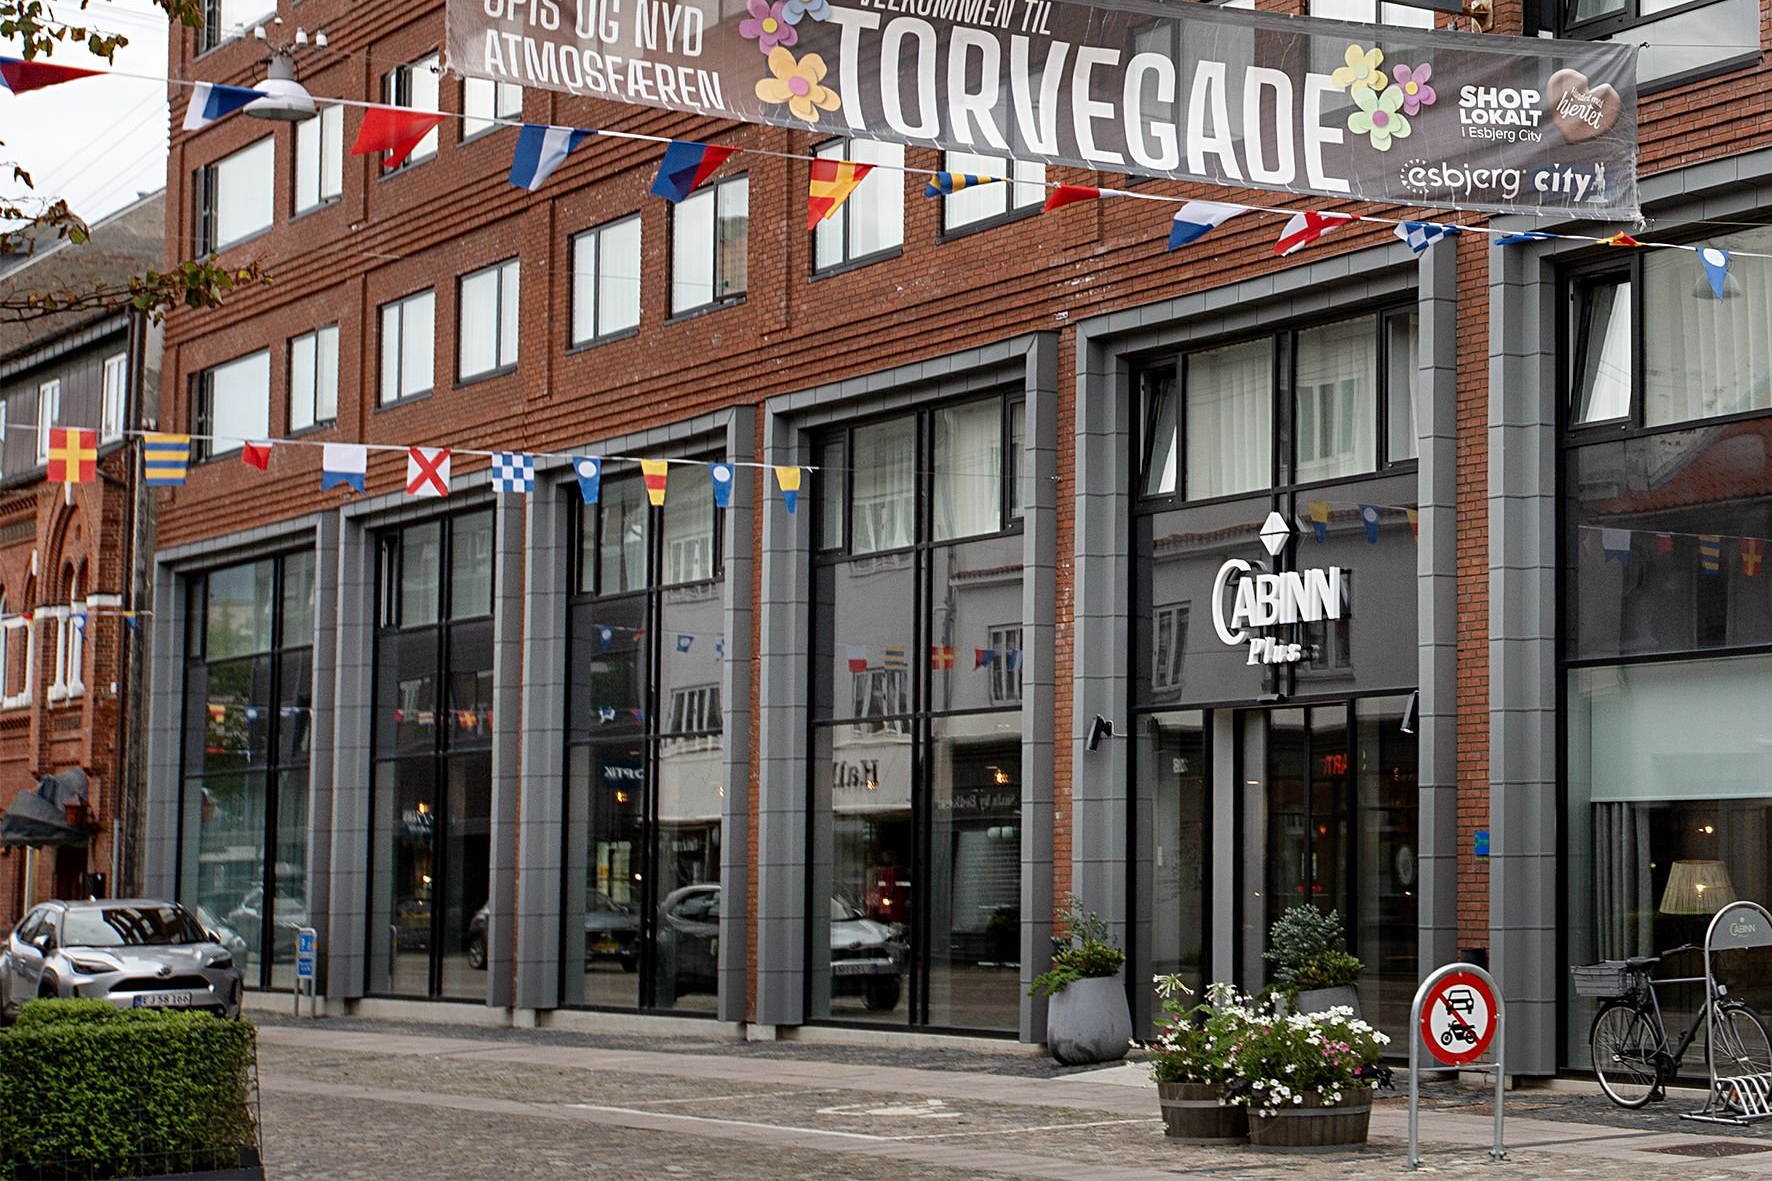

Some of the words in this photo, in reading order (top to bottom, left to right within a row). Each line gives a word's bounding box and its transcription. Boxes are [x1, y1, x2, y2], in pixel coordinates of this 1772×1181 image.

[483, 28, 726, 111] ATMOSFÆREN
[823, 4, 1351, 194] TORVEGADE
[1458, 85, 1541, 110] SHOP
[1459, 108, 1543, 127] LOKALT
[1556, 90, 1604, 130] hjertet
[1461, 126, 1466, 137] i
[1469, 127, 1516, 143] Esbjerg
[1518, 129, 1543, 143] City
[1407, 162, 1521, 200] esbjerg
[1533, 163, 1592, 203] city
[1211, 558, 1341, 646] CABINN
[1246, 636, 1302, 666] Plus
